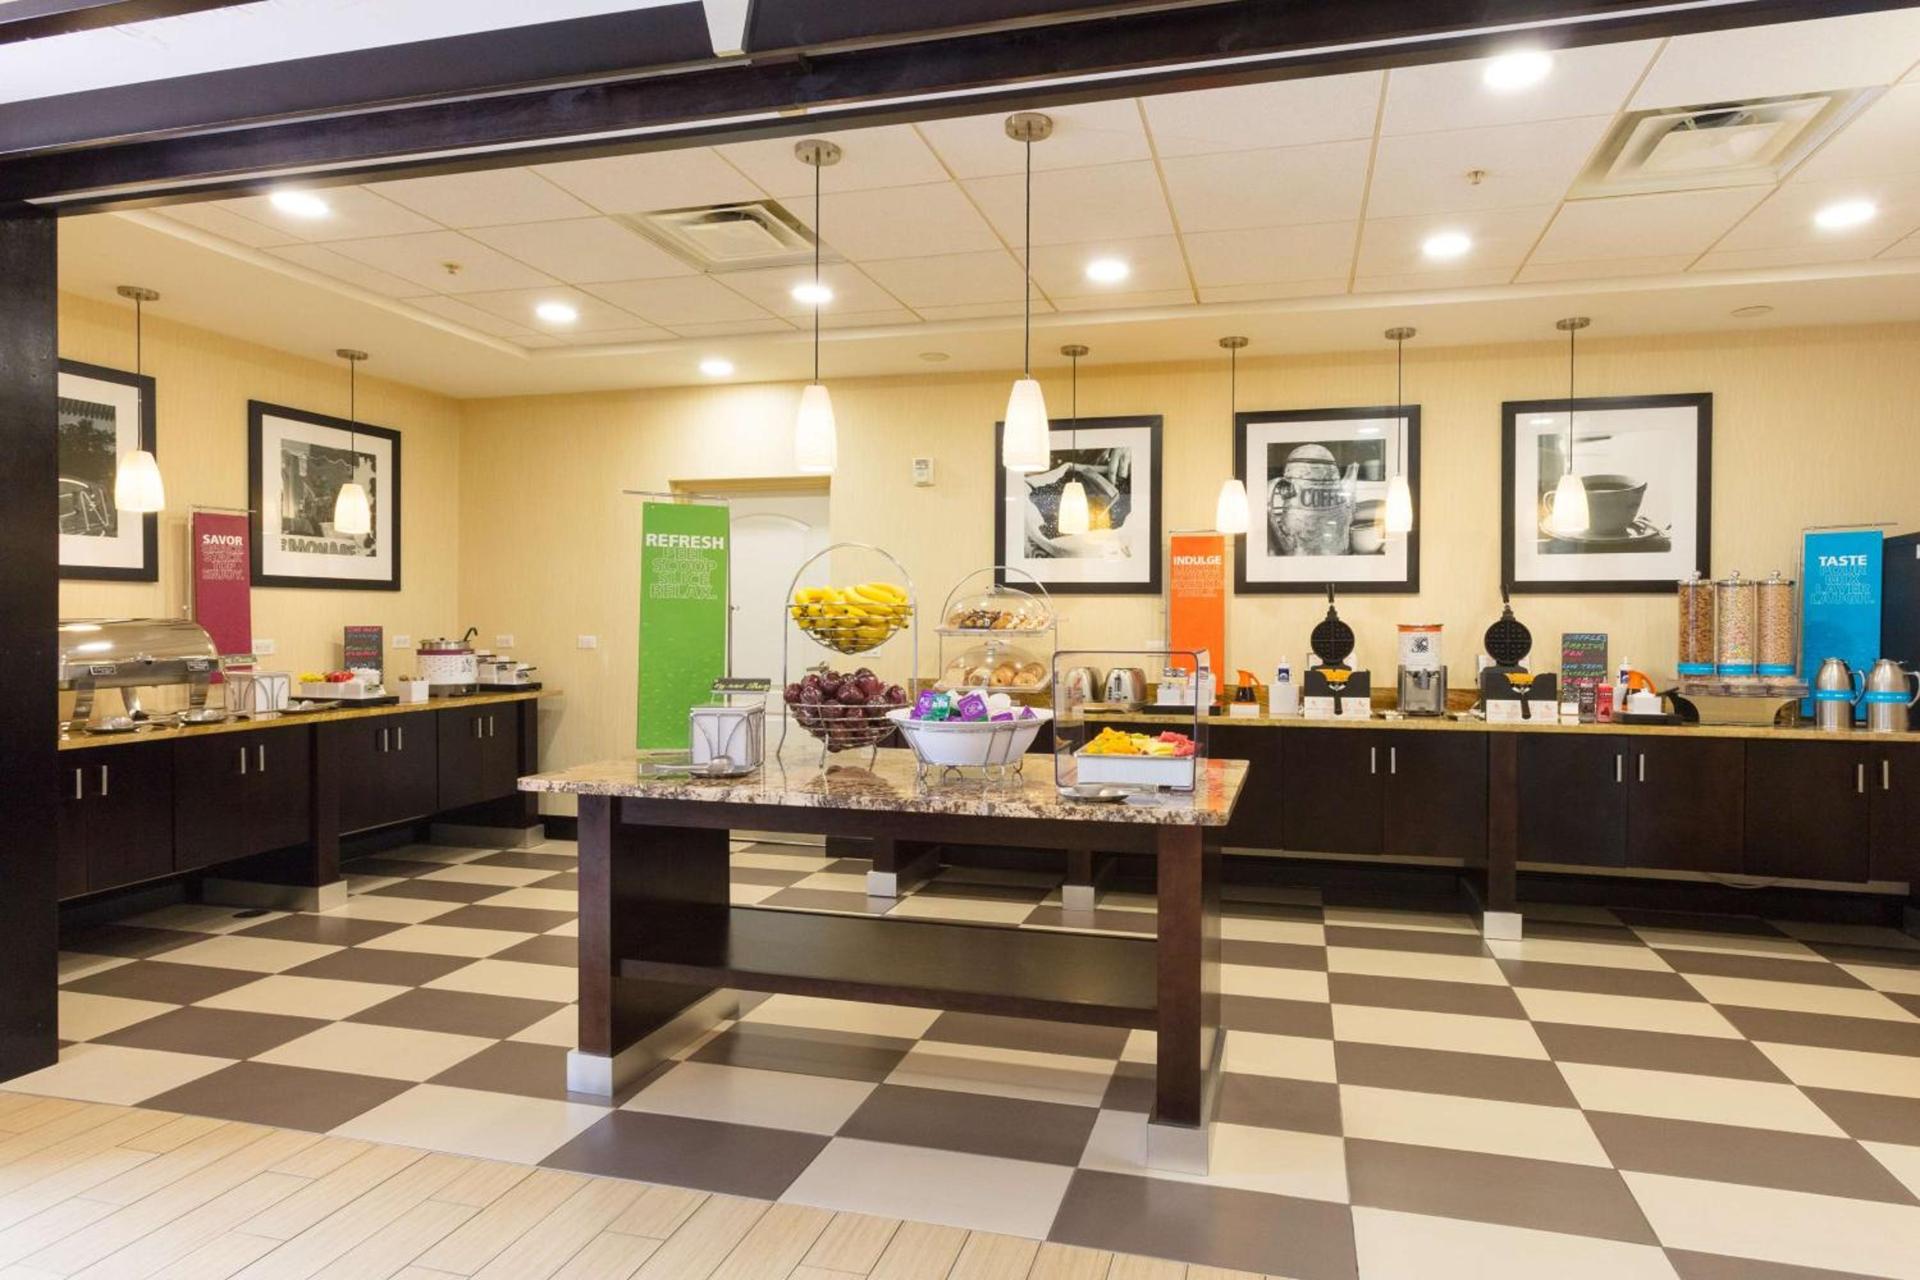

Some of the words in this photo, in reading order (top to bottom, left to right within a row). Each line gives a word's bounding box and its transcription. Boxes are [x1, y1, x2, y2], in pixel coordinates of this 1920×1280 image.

[202, 534, 244, 546] SAVOR
[645, 533, 724, 549] REFRESH
[651, 558, 718, 573] SCOOP
[1173, 555, 1222, 566] INDULGE
[1818, 554, 1868, 567] TASTE
[656, 571, 711, 586] SLICE
[649, 583, 718, 600] RELAX.
